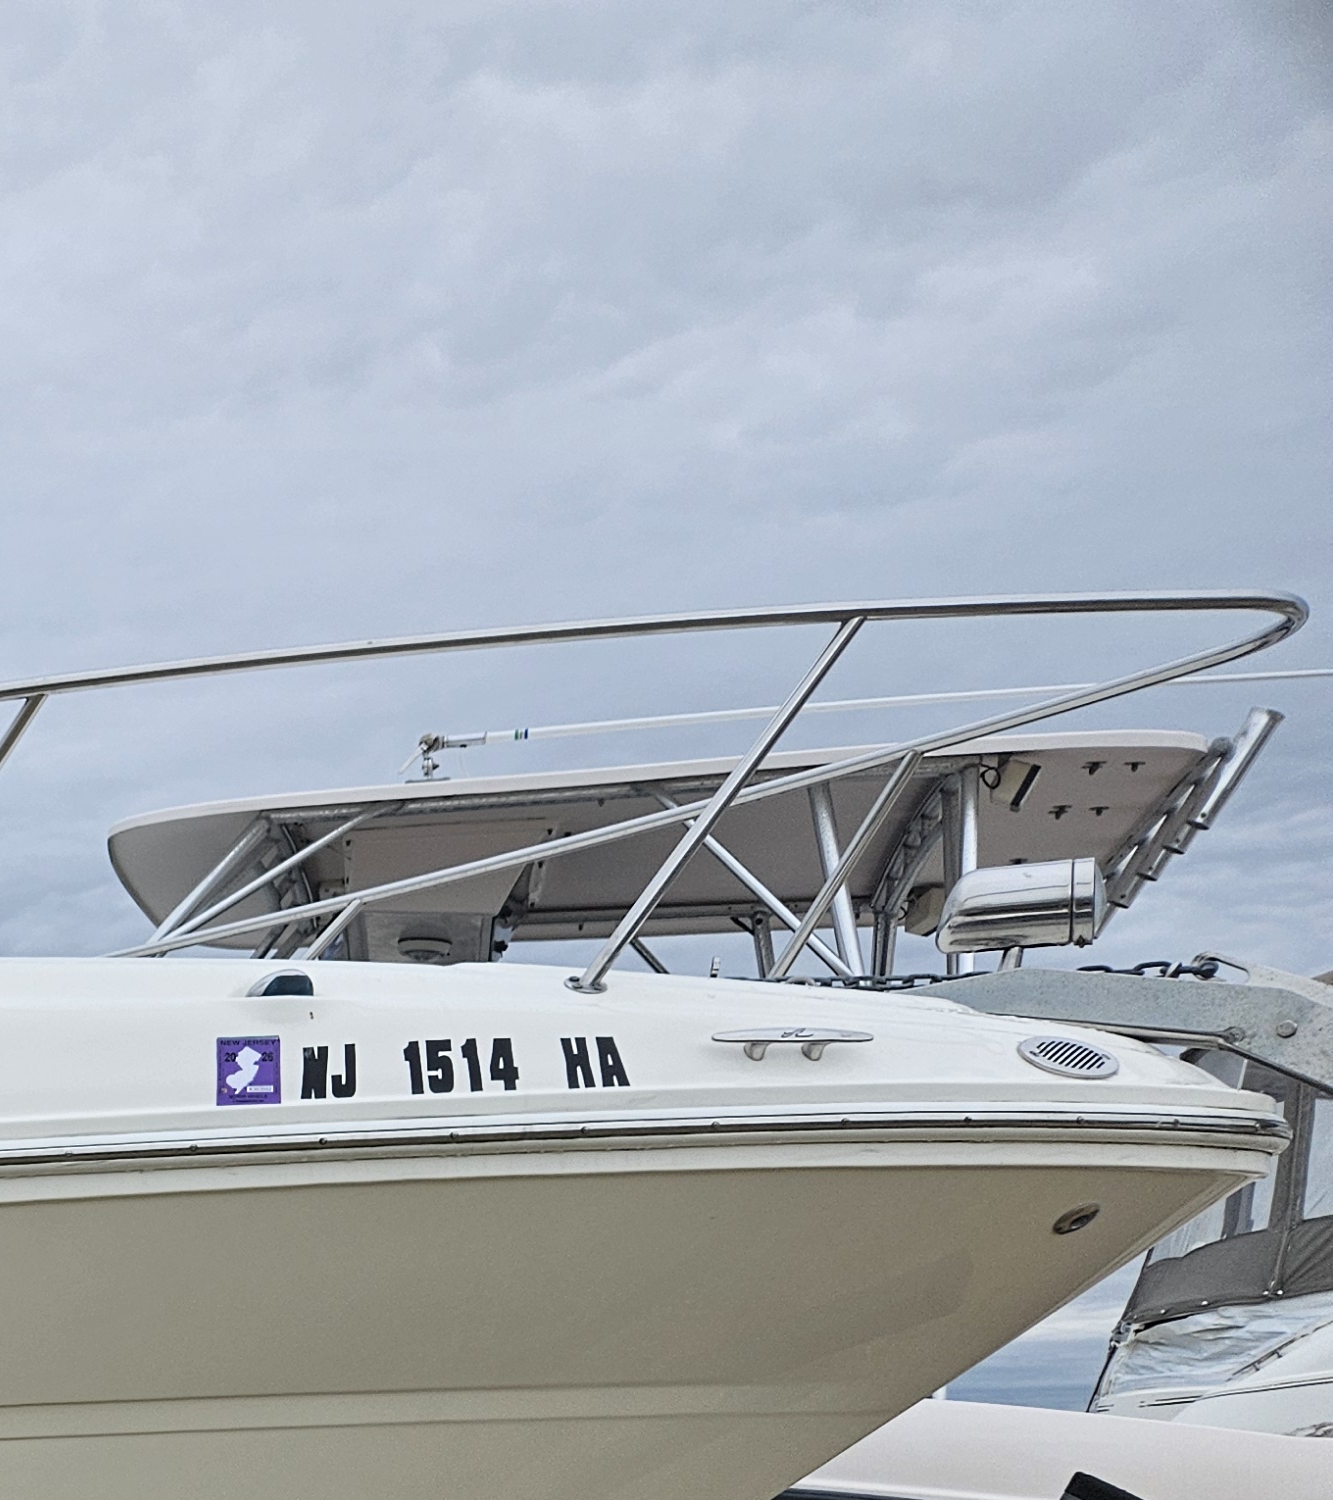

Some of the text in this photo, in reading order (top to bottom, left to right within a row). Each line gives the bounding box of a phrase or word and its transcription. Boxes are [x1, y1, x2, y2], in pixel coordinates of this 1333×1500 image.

[224, 1051, 237, 1063] 20
[300, 1036, 631, 1100] NJ 1514 HA
